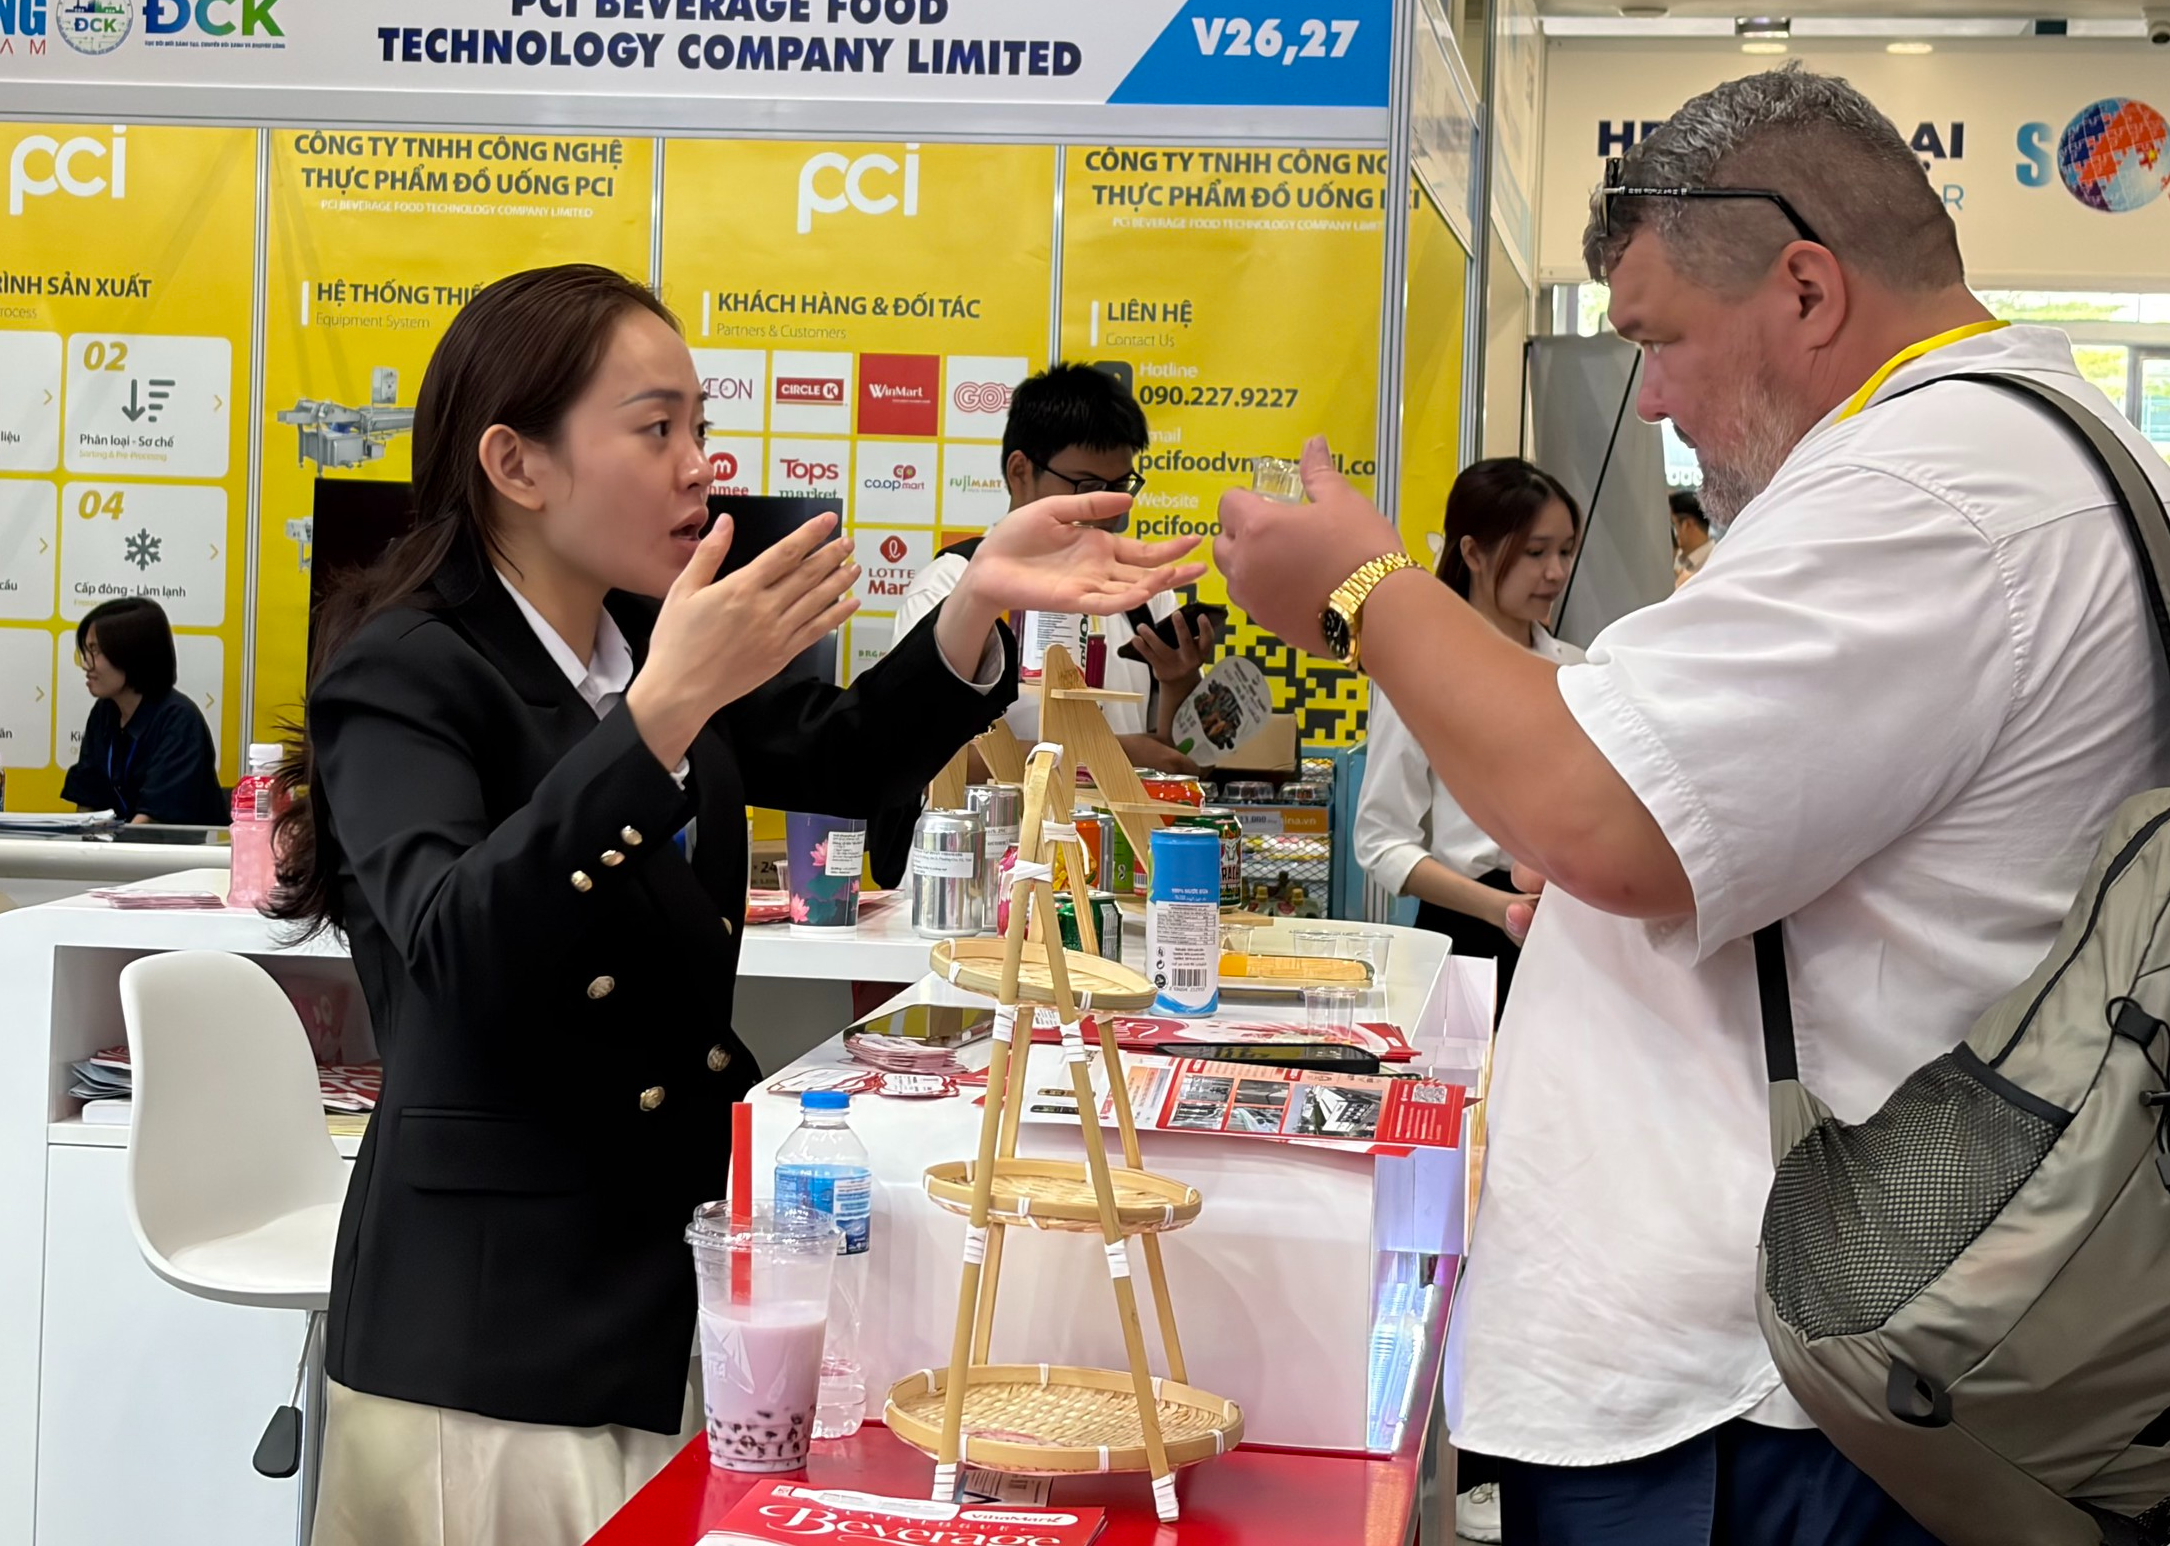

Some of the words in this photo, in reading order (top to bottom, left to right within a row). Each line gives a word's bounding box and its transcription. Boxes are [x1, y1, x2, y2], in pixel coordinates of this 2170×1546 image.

[74, 17, 117, 33] ĐCK
[142, 0, 285, 37] ĐCK
[378, 27, 665, 68] TECHNOLOGY
[677, 33, 895, 73] COMPANY
[908, 38, 1082, 76] LIMITED
[1192, 17, 1360, 66] V26,27
[294, 130, 364, 156] CÔNG
[368, 137, 399, 158] TY
[403, 137, 473, 160] TNHH
[478, 135, 548, 162] CÔNG
[553, 139, 623, 170] NGHỆ
[1085, 146, 1157, 171] CÔNG
[1162, 152, 1195, 172] TY
[1198, 152, 1271, 175] TNHH
[1277, 148, 1350, 175] CÔNG
[9, 125, 127, 215] pci
[301, 166, 369, 196] THỰC
[374, 163, 448, 192] PHẨM
[453, 167, 491, 193] ĐỒ
[496, 167, 570, 196] UỐNG
[575, 176, 615, 197] PCI
[797, 142, 920, 234] pci
[1092, 182, 1163, 213] THỰC
[1169, 178, 1246, 208] PHẨM
[1251, 179, 1291, 208] ĐỒ
[1297, 180, 1373, 210] UỐNG
[321, 200, 338, 210] PCI
[339, 200, 393, 212] BEVERAGE
[394, 201, 424, 213] FOOD
[426, 203, 496, 216] TECHNOLOGY
[498, 205, 549, 217] COMPANY
[550, 207, 593, 219] LIMITED
[47, 271, 91, 296] SẢN
[95, 273, 152, 298] XUẤT
[317, 279, 346, 307] HỆ
[350, 279, 430, 305] THỐNG
[717, 290, 796, 314] KHÁCH
[801, 291, 867, 316] HÀNG
[872, 298, 889, 316] &
[893, 292, 935, 318] ĐỐI
[938, 295, 981, 319] TÁC
[1107, 299, 1157, 323] LIÊN
[1162, 299, 1194, 329] HỆ
[316, 312, 383, 328] Equipment
[386, 313, 430, 330] System
[717, 323, 766, 338] Partners
[768, 324, 778, 338] &
[780, 324, 847, 339] Customers
[1106, 334, 1155, 347] Contact
[1159, 334, 1175, 348] Us
[83, 341, 128, 371] 02
[1139, 363, 1198, 378] Hotline
[780, 384, 821, 396] CIRCLE
[868, 383, 923, 399] WinMart
[1139, 385, 1299, 408] 090.227.9227
[80, 433, 108, 446] Phân
[110, 435, 130, 448] loại
[1147, 428, 1182, 442] mail
[779, 458, 839, 485] Tops
[78, 490, 124, 520] 04
[1137, 492, 1199, 508] Website
[868, 568, 916, 579] LOTTE
[867, 580, 911, 595] Mar
[759, 1504, 1061, 1546] Beverage
